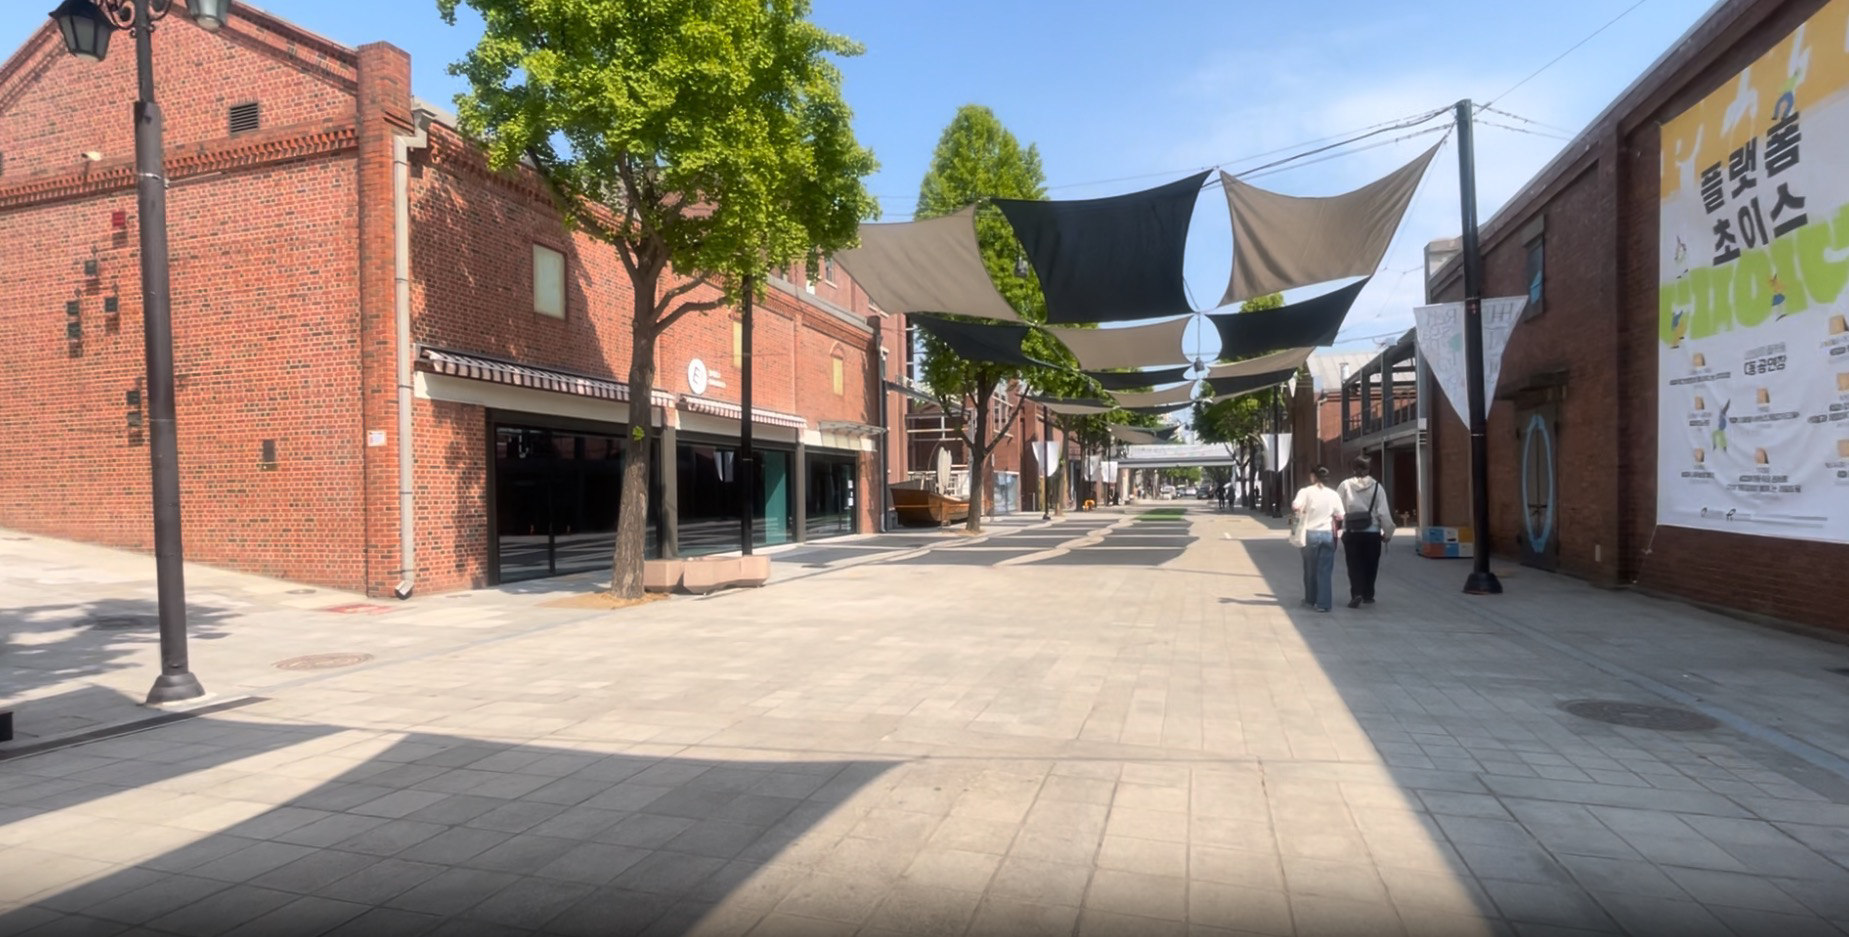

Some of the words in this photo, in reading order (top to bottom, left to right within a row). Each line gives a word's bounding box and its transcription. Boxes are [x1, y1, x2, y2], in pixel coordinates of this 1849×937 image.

[1701, 111, 1801, 214] 플랫폼
[1713, 182, 1808, 266] 초이스
[1744, 355, 1787, 375] 대공연장
